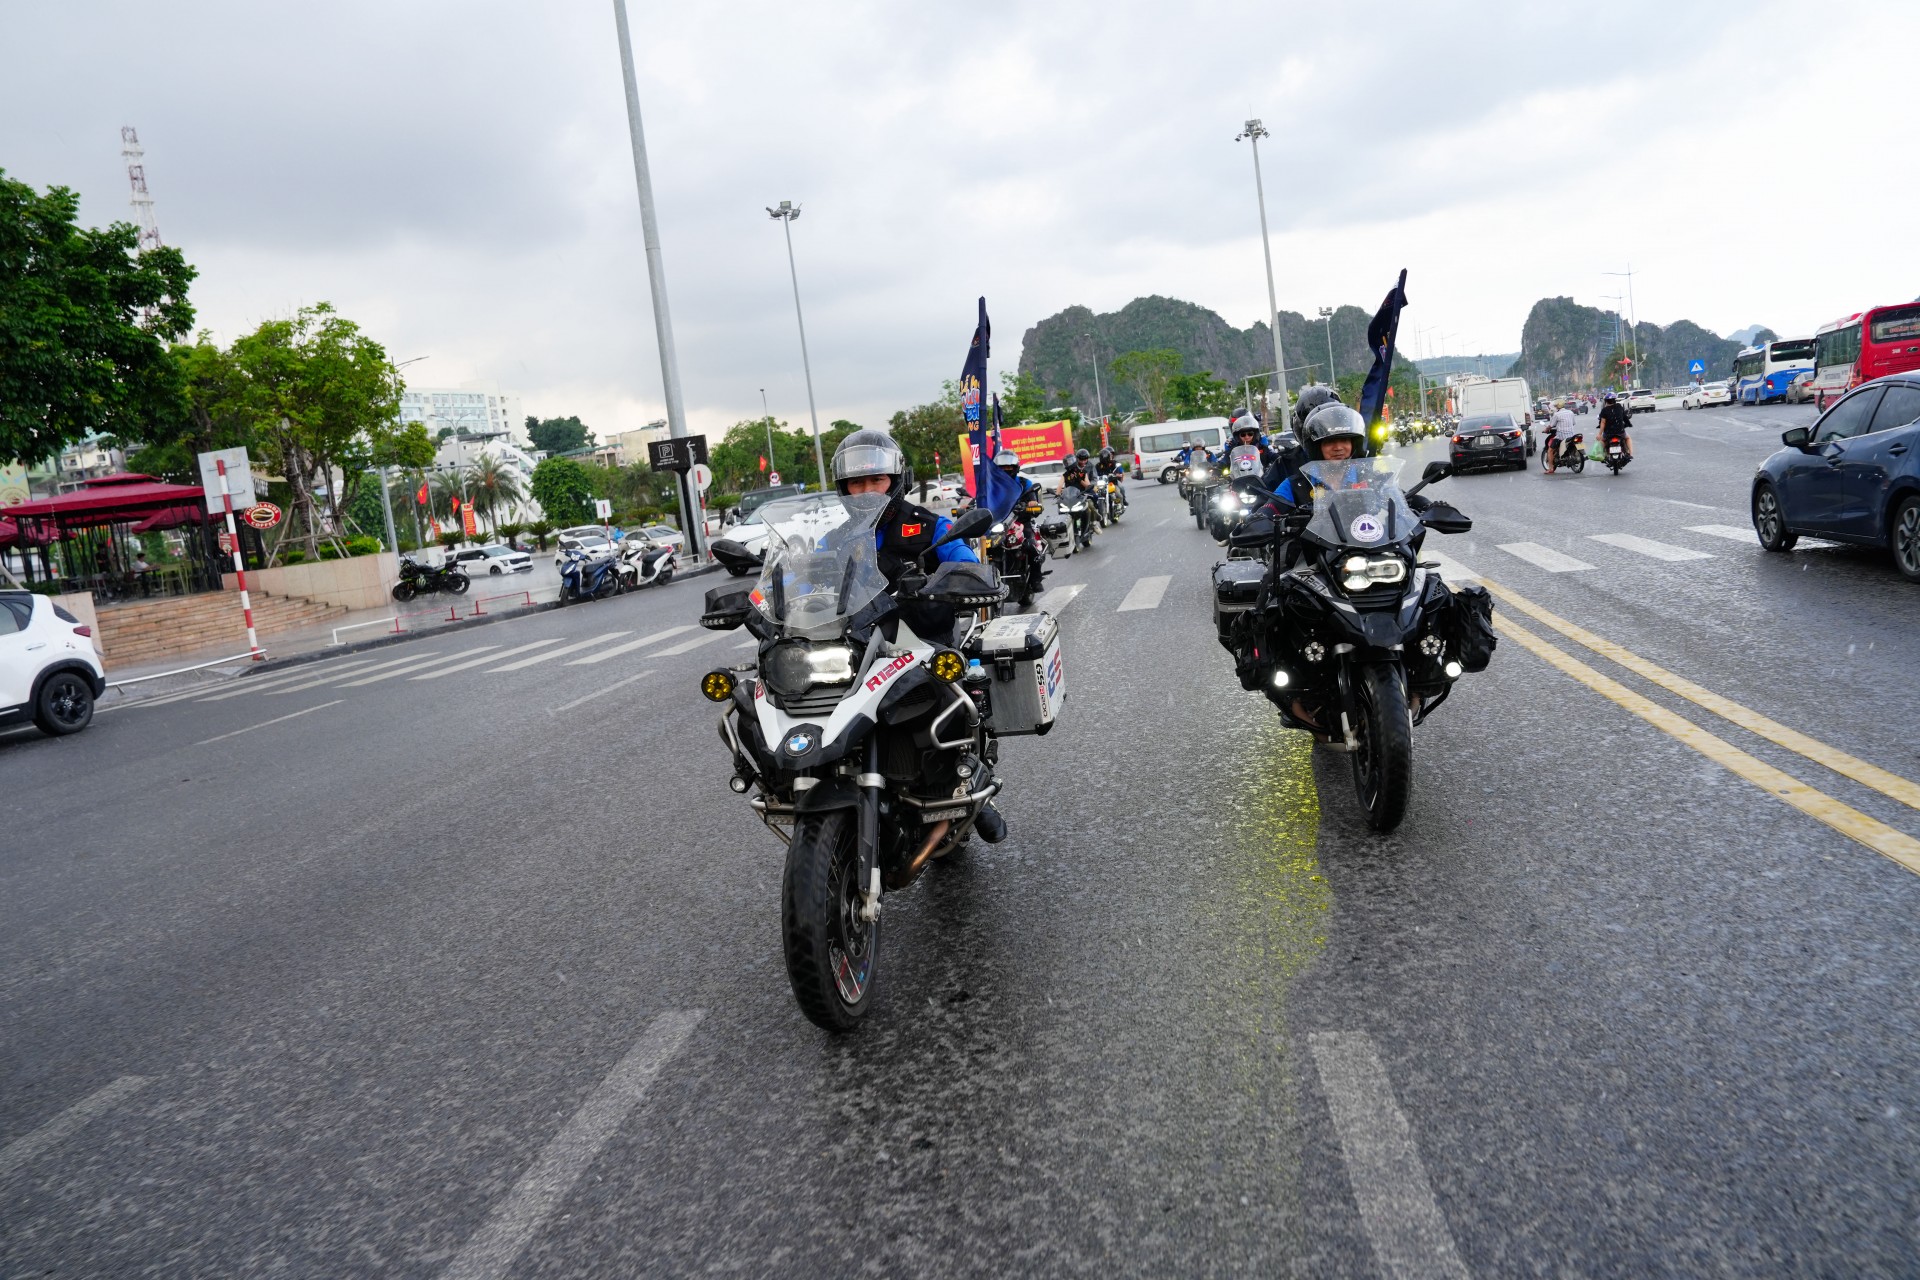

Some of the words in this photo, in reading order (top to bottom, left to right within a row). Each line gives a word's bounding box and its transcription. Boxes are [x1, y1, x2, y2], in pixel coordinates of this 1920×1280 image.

[246, 503, 279, 515] HIGHLANDS
[250, 520, 277, 528] COFFEE
[865, 652, 915, 692] R1200
